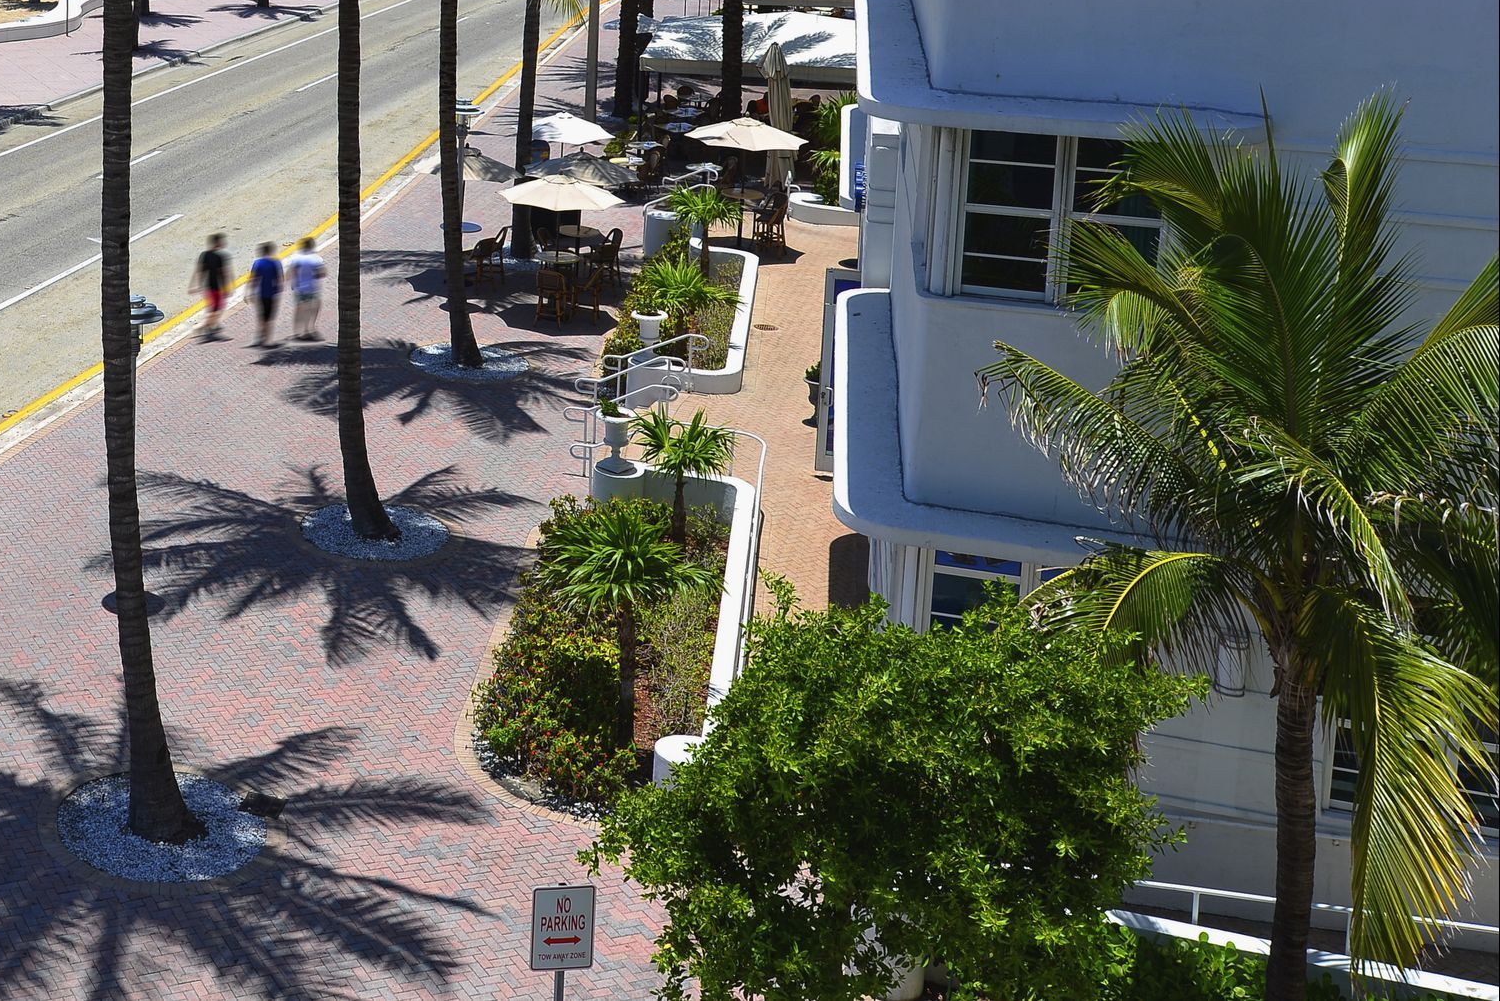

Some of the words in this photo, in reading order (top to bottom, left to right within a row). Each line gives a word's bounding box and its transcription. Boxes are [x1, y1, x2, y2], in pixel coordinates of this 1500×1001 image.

[556, 897, 571, 914] NO
[541, 914, 586, 932] PARKING
[538, 953, 551, 961] TOW
[553, 952, 568, 960] AWAY
[570, 951, 586, 959] ZONE
